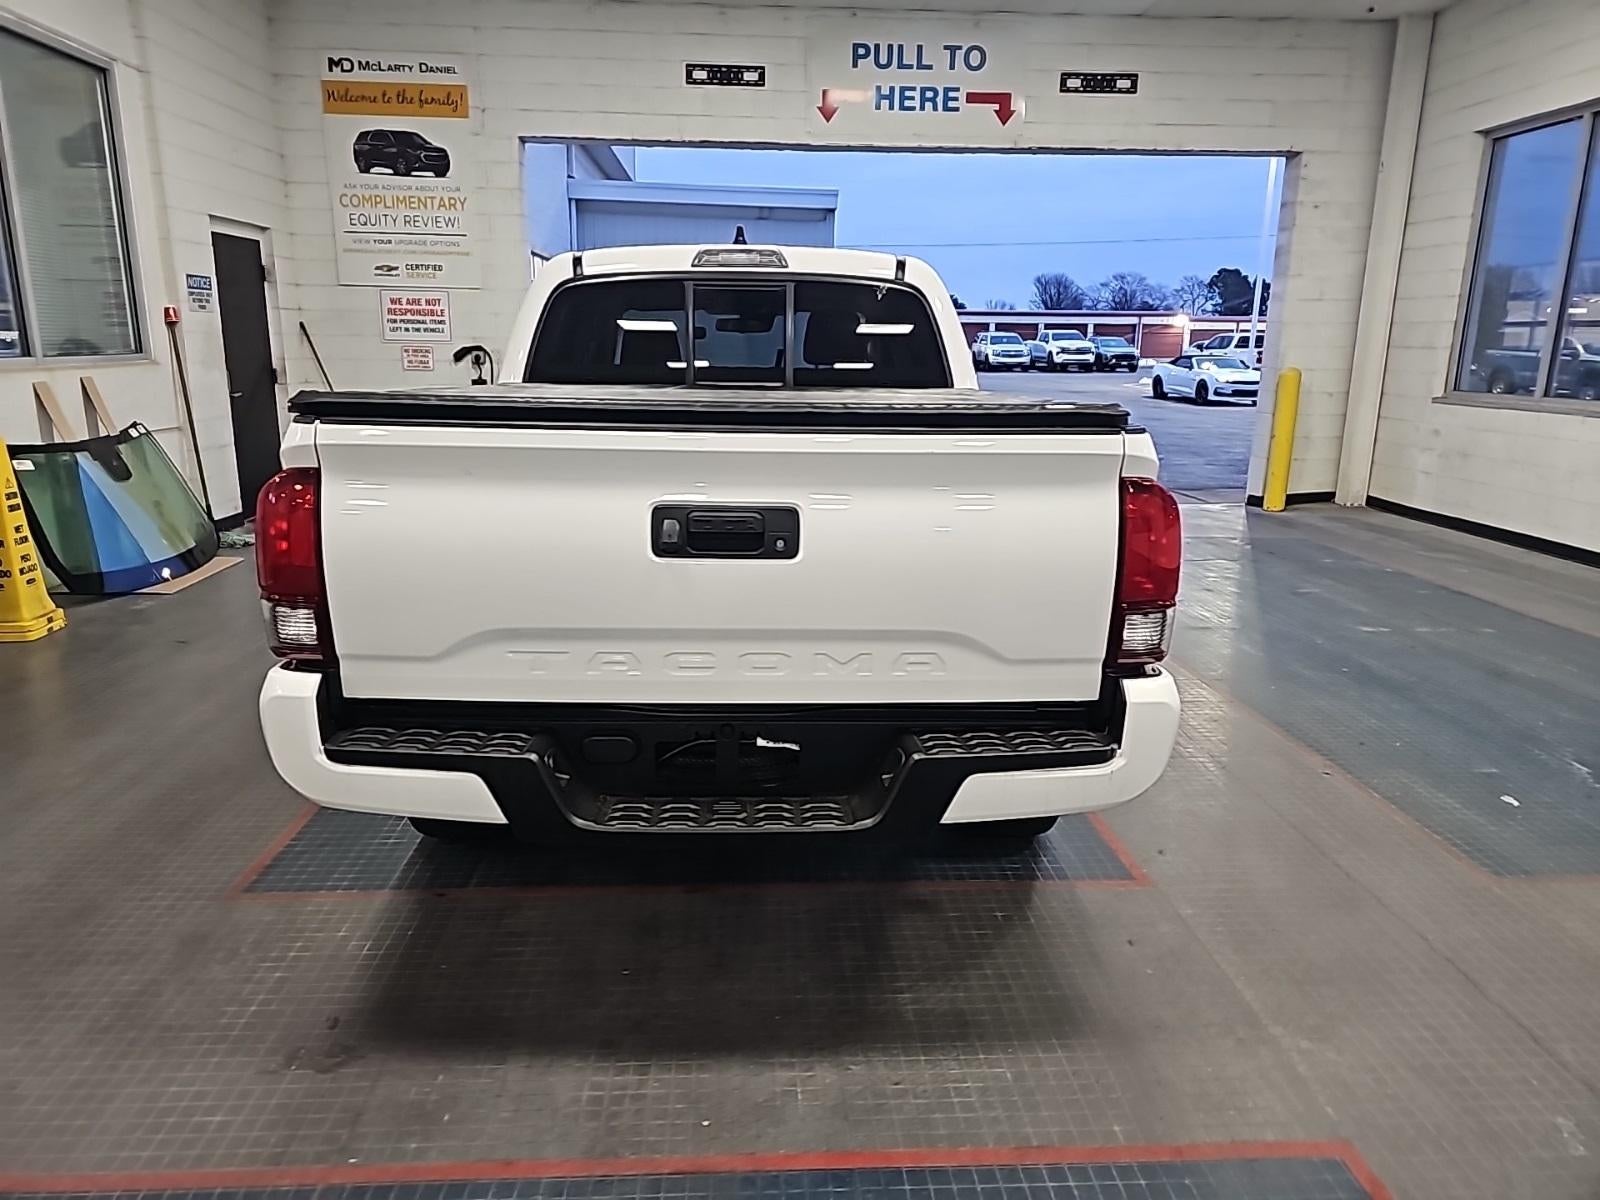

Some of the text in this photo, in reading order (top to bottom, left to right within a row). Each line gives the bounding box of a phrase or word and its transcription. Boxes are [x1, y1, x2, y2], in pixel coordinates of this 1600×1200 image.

[852, 43, 987, 72] PULL TO
[419, 62, 459, 74] DANIEL
[326, 87, 463, 113] Welcome to the family!
[875, 85, 960, 112] HERE
[339, 193, 467, 212] COMPLIMENTARY
[349, 213, 460, 229] EQUITY REVIEW!
[405, 263, 443, 272] CERTIFIED
[188, 277, 211, 288] NOTICE
[389, 297, 442, 307] WE ARE NOT
[387, 307, 446, 317] RESPONSIBLE
[505, 650, 947, 676] TACOMA
